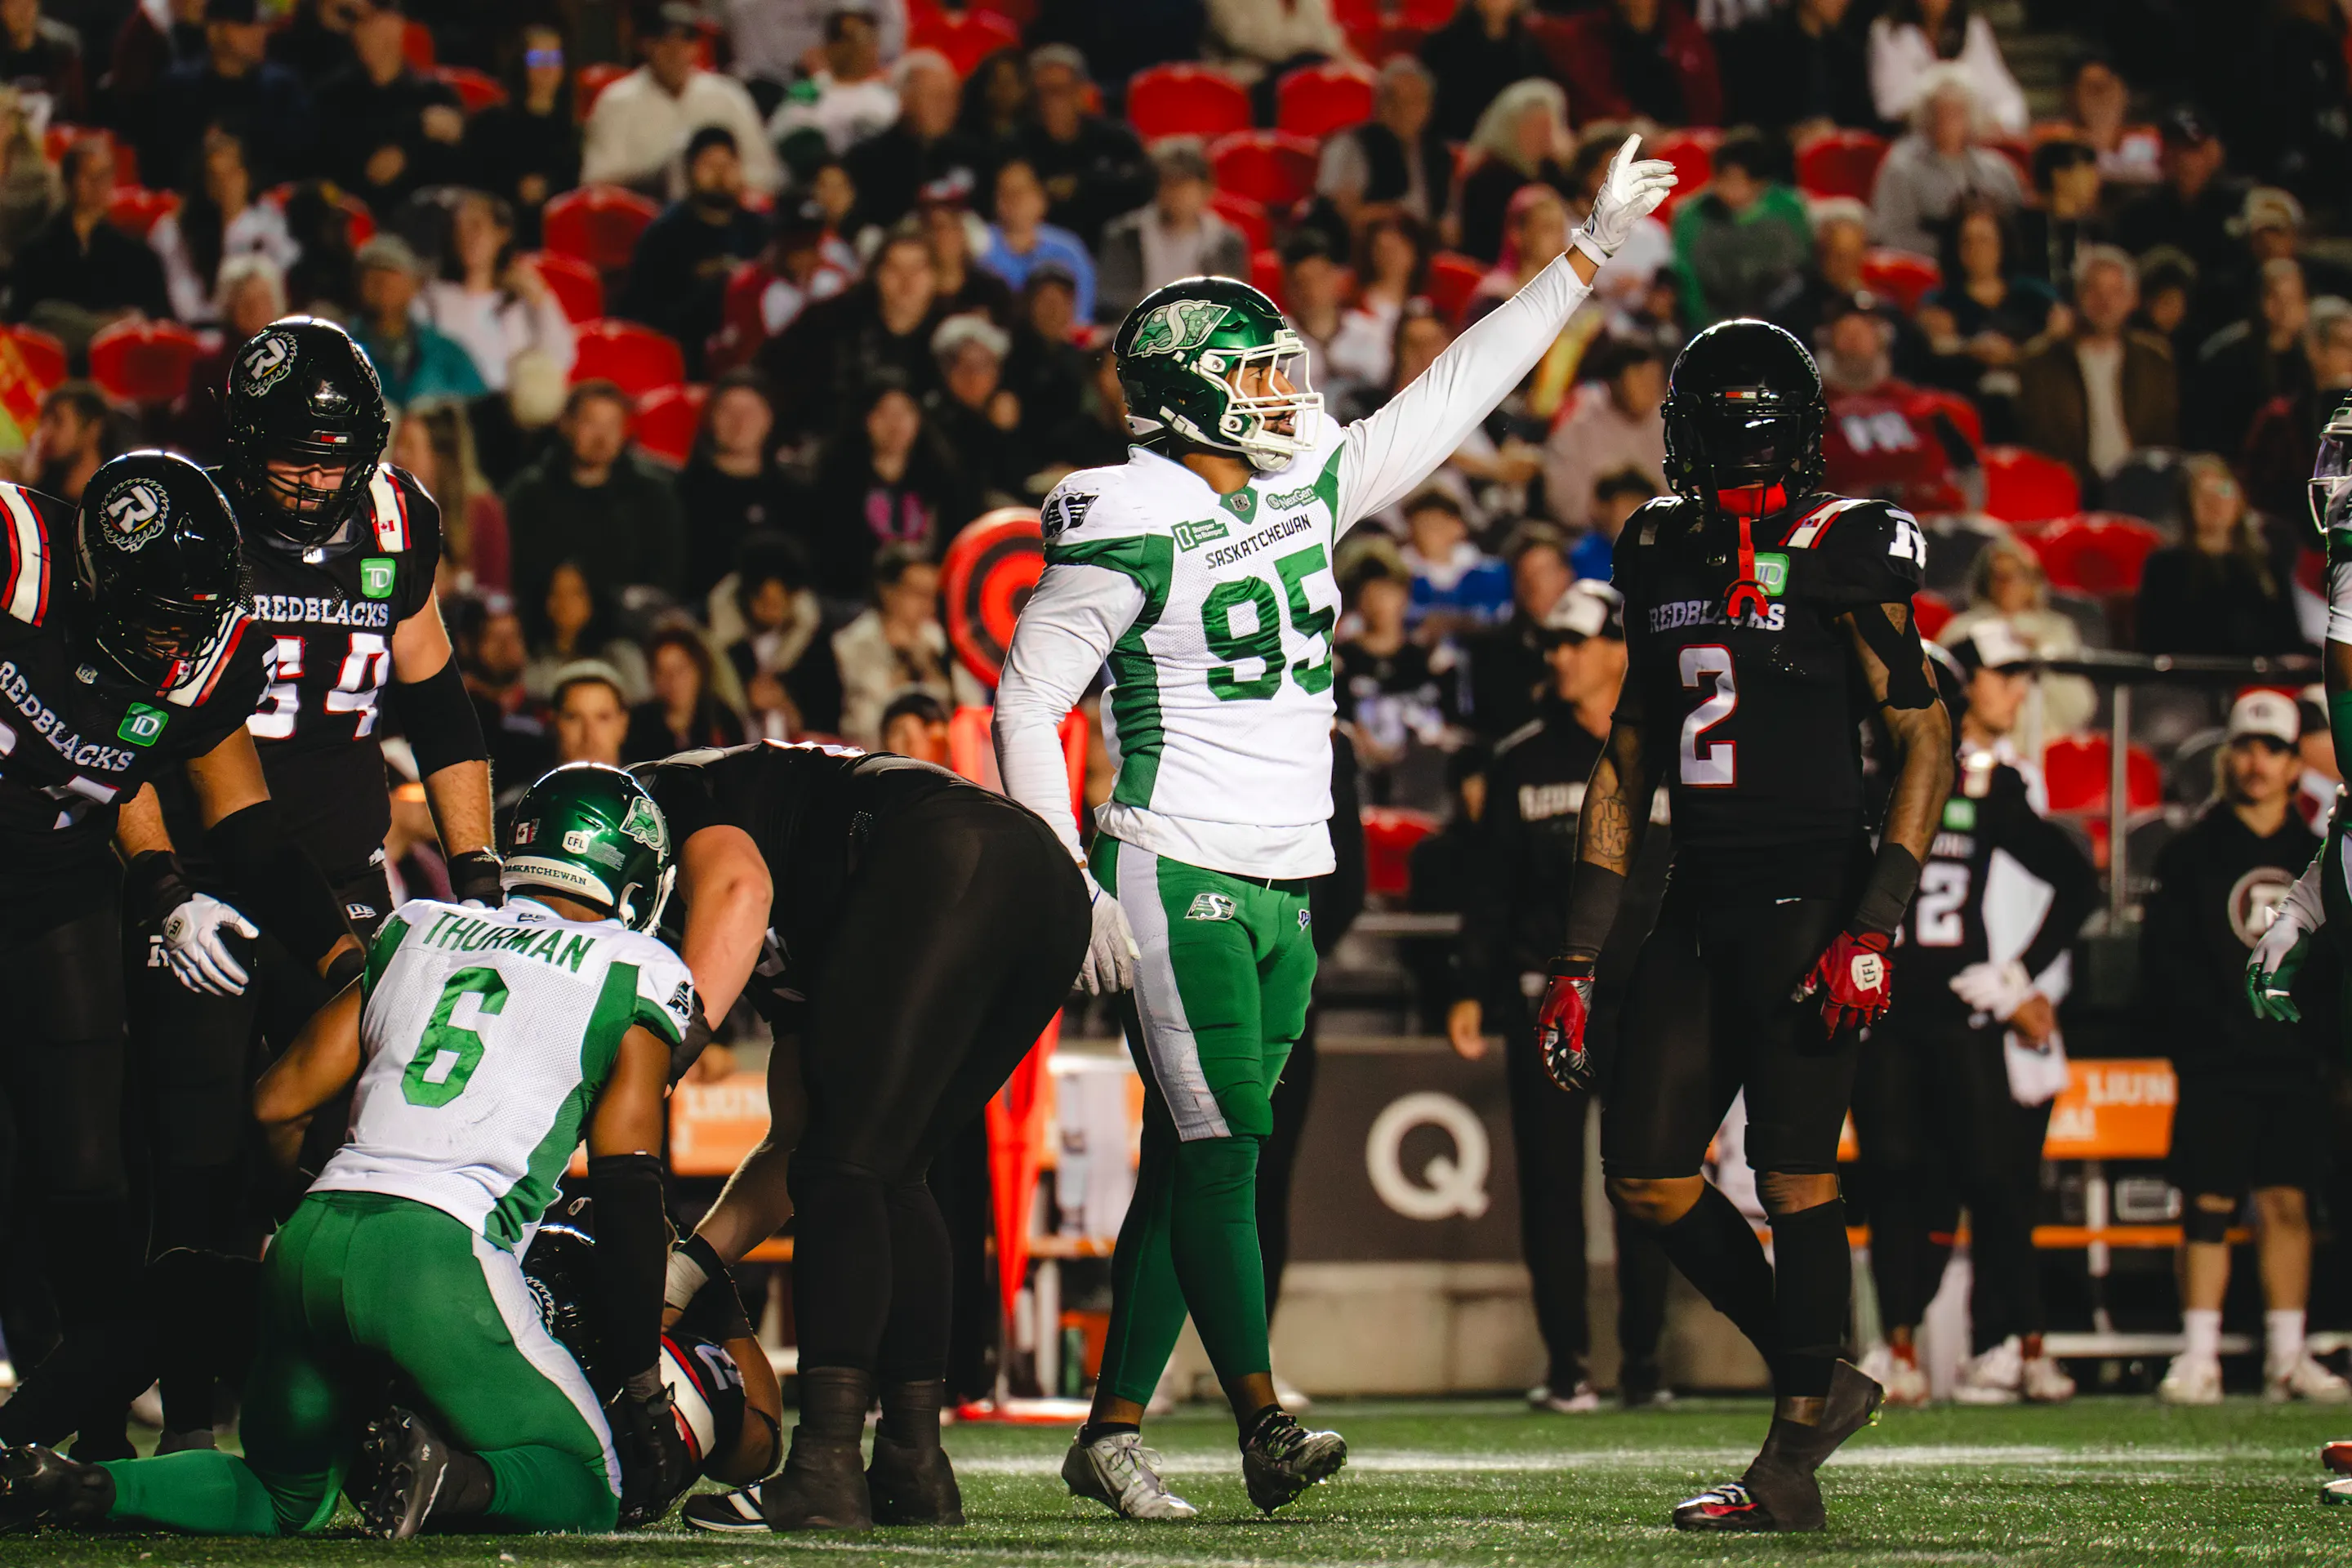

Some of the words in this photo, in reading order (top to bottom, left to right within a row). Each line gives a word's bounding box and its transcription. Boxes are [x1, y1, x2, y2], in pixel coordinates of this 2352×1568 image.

[1279, 488, 1313, 509] NexGen
[1205, 513, 1312, 570] SASKATCHEWAN
[365, 567, 393, 588] TD
[249, 595, 390, 627] REDBLACKS
[1200, 542, 1336, 702] 95
[0, 661, 136, 772] REDBLACKS
[246, 632, 391, 741] 54
[1678, 644, 1739, 788] 2
[567, 835, 585, 849] CFL
[422, 911, 596, 973] THURMAN
[1861, 960, 1877, 983] CFL
[400, 966, 510, 1109] 6
[1365, 1090, 1490, 1220] Q
